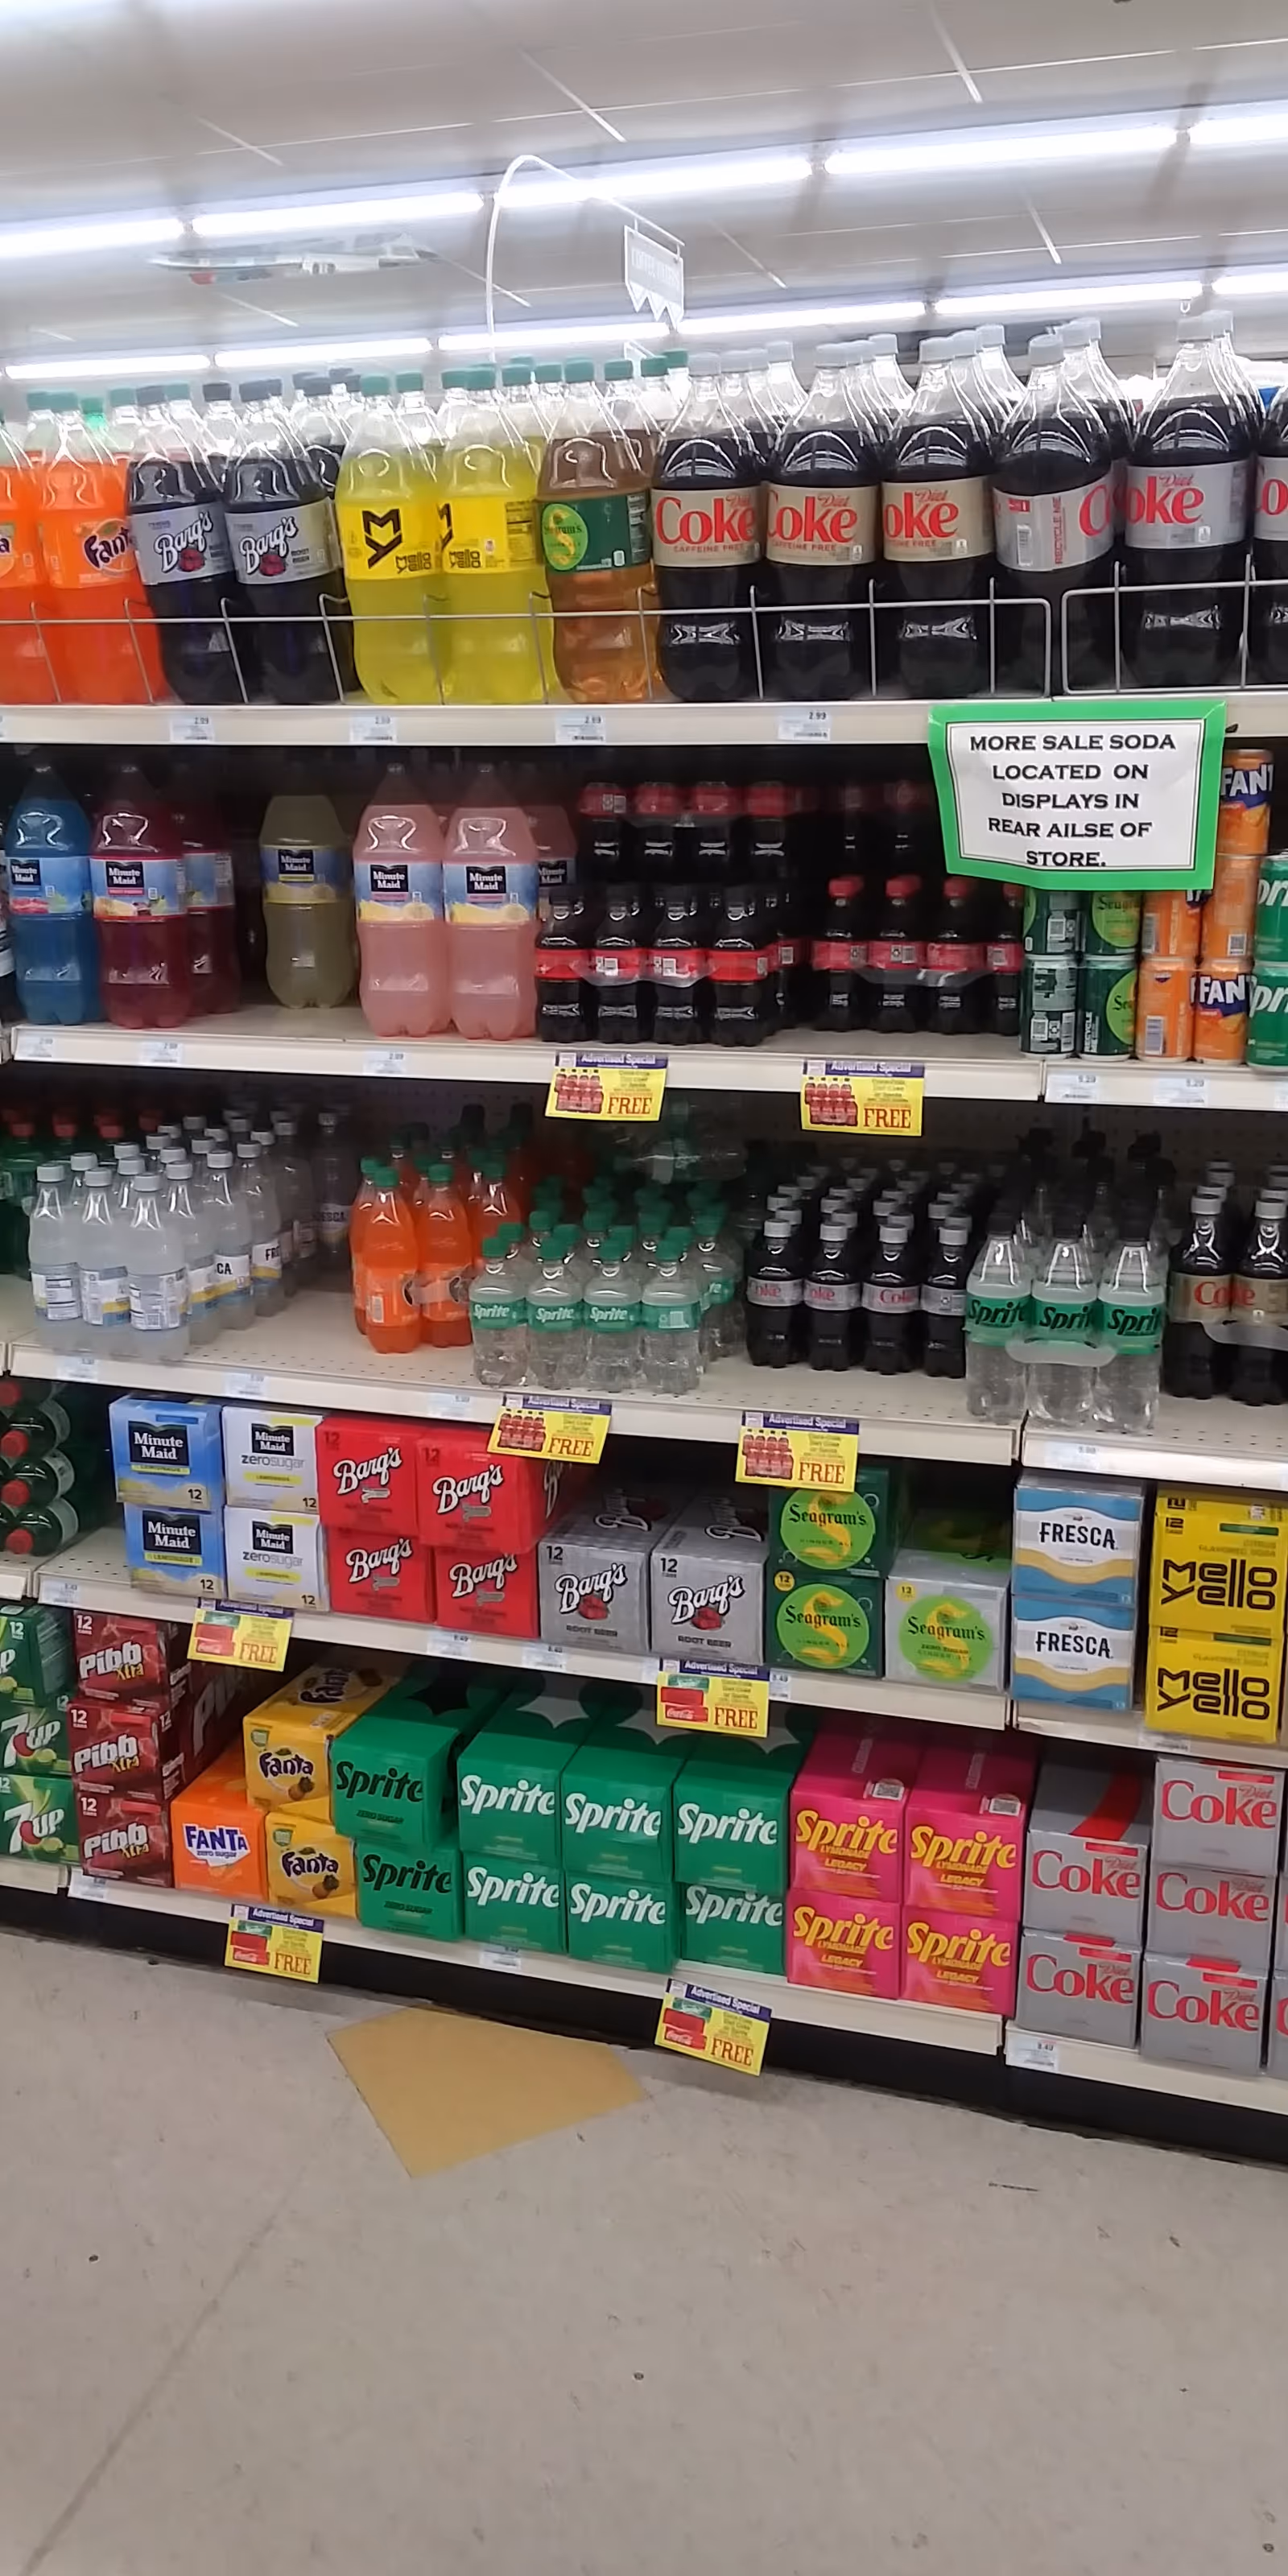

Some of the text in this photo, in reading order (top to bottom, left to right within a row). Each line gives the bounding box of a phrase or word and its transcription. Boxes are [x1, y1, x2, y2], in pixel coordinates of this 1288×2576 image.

[655, 497, 755, 545] Coke
[883, 492, 960, 539] oke
[969, 733, 1176, 751] MORE SALE SODA
[993, 764, 1149, 780] LOCATED ON
[1220, 763, 1274, 797] FANT
[1001, 792, 1139, 809] DISPLAYS IN
[988, 817, 1152, 838] REAR AILSE OF
[280, 855, 311, 865] Minute
[284, 863, 308, 872] Maid
[1026, 851, 1107, 867] STORE.
[107, 867, 141, 877] Minute
[112, 876, 137, 886] Maid
[373, 871, 405, 881] Minute
[469, 872, 504, 883] Minute
[377, 879, 401, 890] Maid
[473, 881, 499, 891] Maid
[607, 1096, 653, 1115] FREE
[864, 1108, 911, 1129] FREE
[473, 1303, 510, 1319] Sprite
[535, 1307, 574, 1323] Sprite
[589, 1307, 628, 1322] Sprite
[134, 1431, 184, 1447] Minute
[255, 1430, 291, 1443] Minute
[324, 1431, 341, 1445] 12
[141, 1446, 177, 1460] Maid
[260, 1441, 286, 1452] Maid
[425, 1448, 440, 1461] 12
[548, 1437, 594, 1456] FREE
[799, 1461, 845, 1484] FREE
[188, 1488, 202, 1500] 12
[303, 1497, 317, 1508] 12
[789, 1503, 867, 1527] Seagram's
[1166, 1517, 1184, 1528] 12
[147, 1521, 196, 1538] Minute
[256, 1529, 291, 1542] Minute
[1039, 1522, 1117, 1550] FRESCA
[155, 1534, 191, 1549] Maid
[261, 1538, 286, 1550] Maid
[546, 1545, 564, 1561] 12
[660, 1557, 678, 1573] 12
[200, 1579, 214, 1590] 12
[301, 1594, 316, 1605] 12
[76, 1615, 93, 1630] 12
[785, 1605, 861, 1628] Seagram's
[10, 1621, 24, 1635] 12
[907, 1616, 986, 1640] Seagram's
[678, 1635, 732, 1648] ROOT BEER
[1035, 1631, 1111, 1658] FRESCA
[80, 1641, 142, 1679] Pibb
[241, 1642, 278, 1664] FREE
[71, 1709, 87, 1724] 12
[714, 1707, 758, 1729] FREE
[74, 1734, 139, 1774] Pibb
[259, 1752, 314, 1777] Fanta
[336, 1761, 423, 1802] Sprite
[460, 1774, 555, 1814] Sprite
[81, 1797, 97, 1811] 12
[1161, 1779, 1278, 1829] Coke
[565, 1793, 661, 1836] Sprite
[678, 1803, 778, 1845] Sprite
[795, 1810, 898, 1854] Sprite
[84, 1822, 148, 1860] Pibb
[186, 1825, 247, 1850] FANTA
[910, 1826, 1016, 1868] Sprite
[282, 1852, 339, 1876] Fanta
[824, 1858, 867, 1872] LEGACY
[363, 1854, 452, 1894] Sprite
[939, 1874, 985, 1887] LEGACY
[1031, 1850, 1140, 1899] Coke
[467, 1867, 559, 1908] Sprite
[570, 1883, 666, 1925] Sprite
[686, 1885, 782, 1926] Sprite
[1155, 1872, 1269, 1922] Coke
[794, 1906, 894, 1951] Sprite
[907, 1922, 1011, 1967] Sprite
[275, 1952, 312, 1975] FREE
[821, 1954, 863, 1968] LEGACY
[936, 1970, 979, 1984] LEGACY
[1026, 1954, 1134, 2004] Coke
[732, 1997, 761, 2015] Special
[1147, 1979, 1260, 2032] Coke
[711, 2037, 754, 2066] FREE
